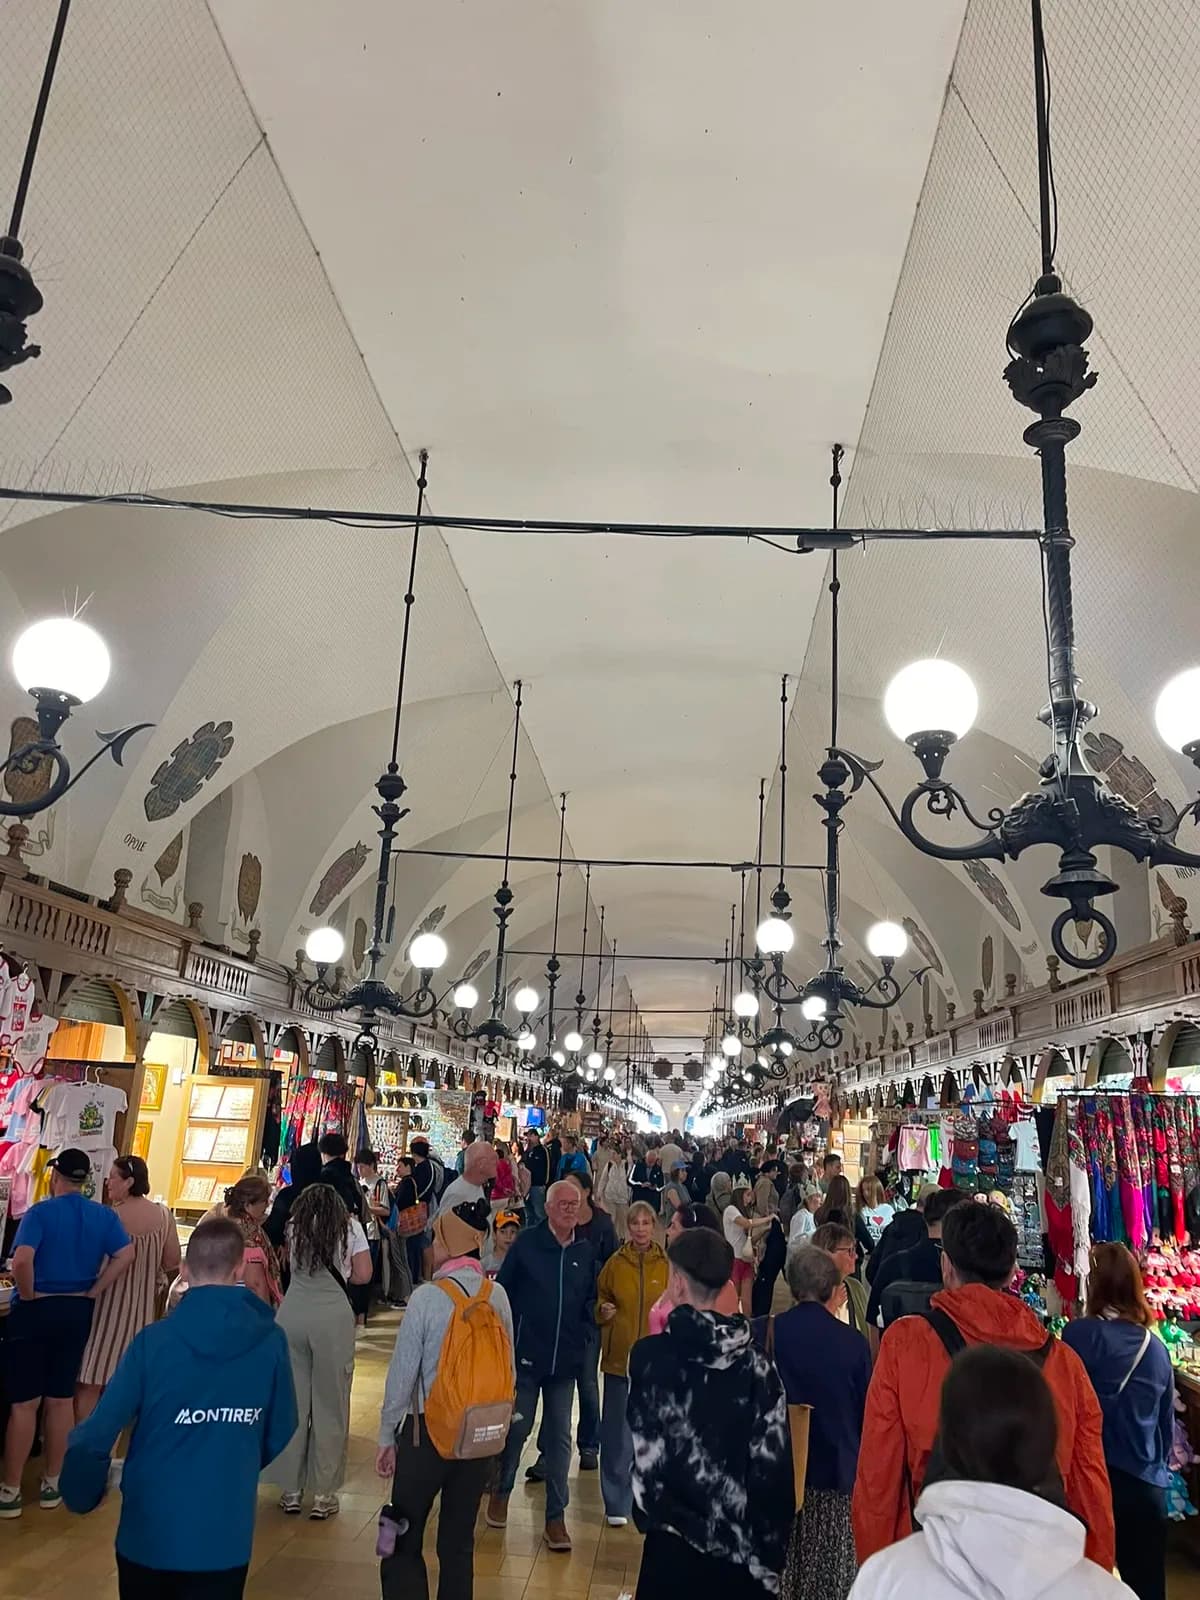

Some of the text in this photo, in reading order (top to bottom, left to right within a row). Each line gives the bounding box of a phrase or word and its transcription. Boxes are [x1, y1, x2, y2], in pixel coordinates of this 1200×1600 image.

[123, 832, 147, 852] OPOLE
[865, 1215, 872, 1227] I
[174, 1407, 263, 1426] MONTIREX
